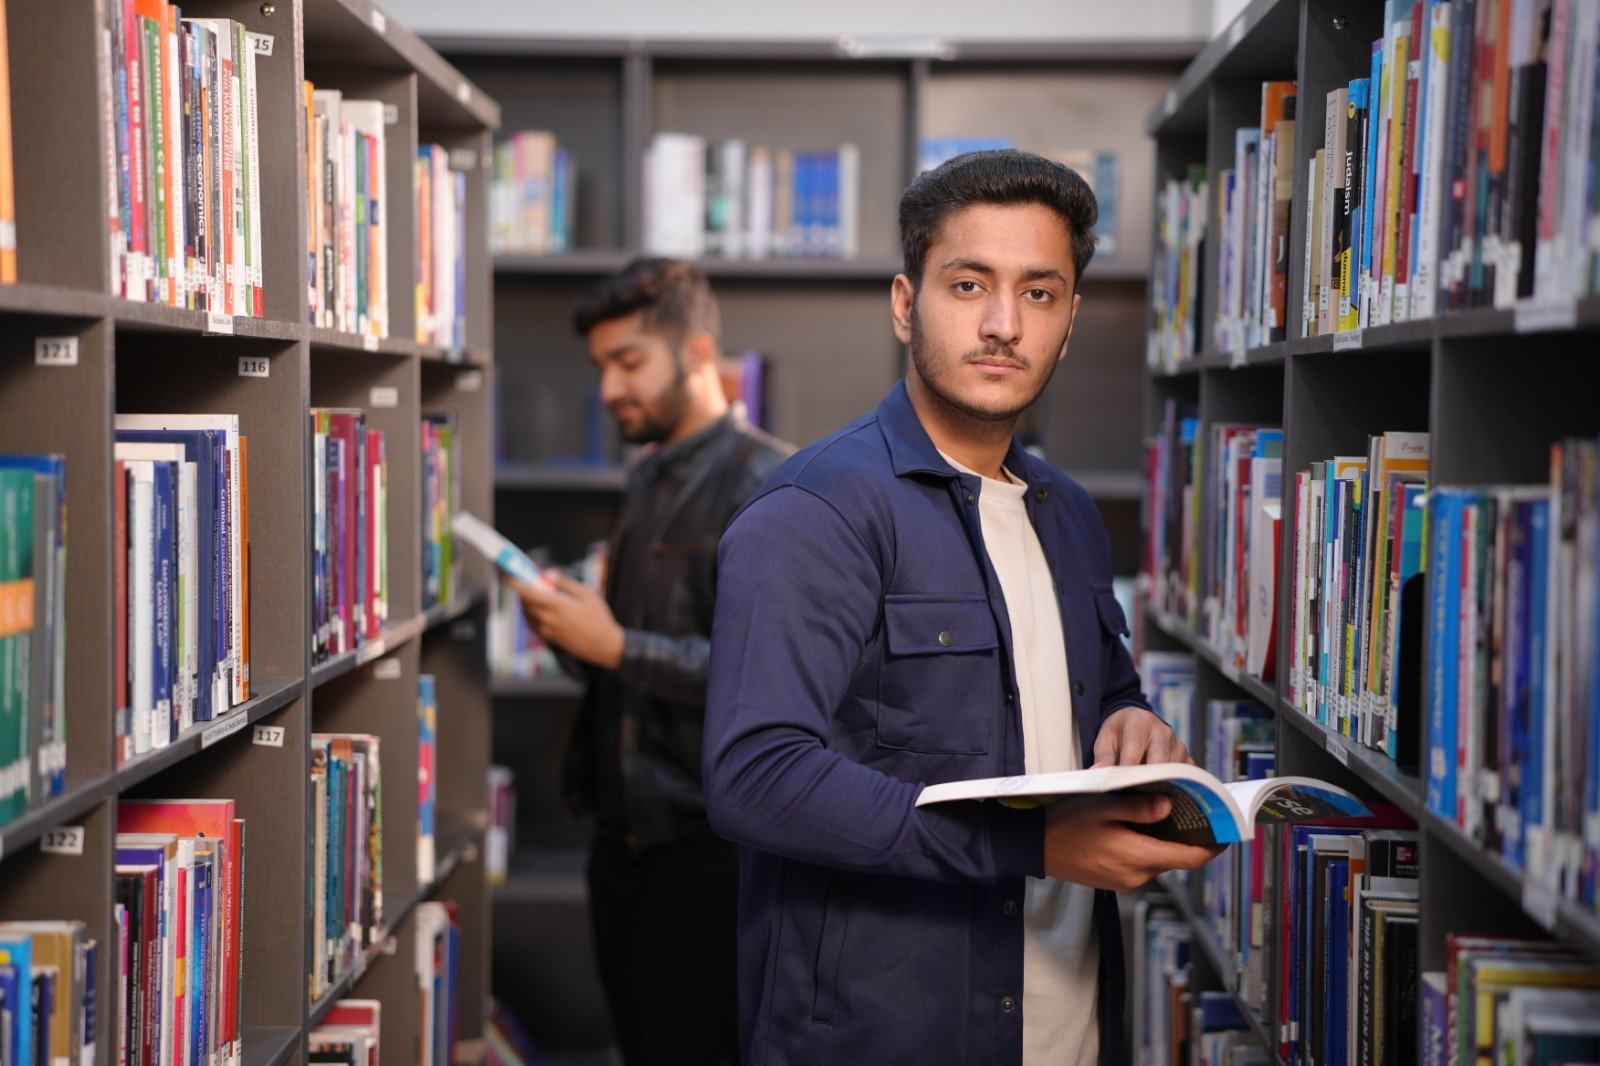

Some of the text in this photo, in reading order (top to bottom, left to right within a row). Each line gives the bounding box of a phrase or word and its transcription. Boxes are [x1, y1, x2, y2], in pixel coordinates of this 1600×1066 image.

[254, 38, 269, 51] 15
[131, 61, 139, 101] Intro
[154, 36, 163, 145] STARBUCKED
[133, 105, 140, 123] to
[196, 110, 204, 237] microeconomics
[1343, 150, 1354, 216] Judaism
[1384, 151, 1395, 260] SOCIAL RESEARCH
[42, 343, 71, 360] 121
[243, 361, 266, 374] 116
[1332, 604, 1340, 688] COMMUNICATION
[257, 730, 280, 742] 117
[48, 832, 77, 848] 122
[1363, 917, 1371, 946] THE
